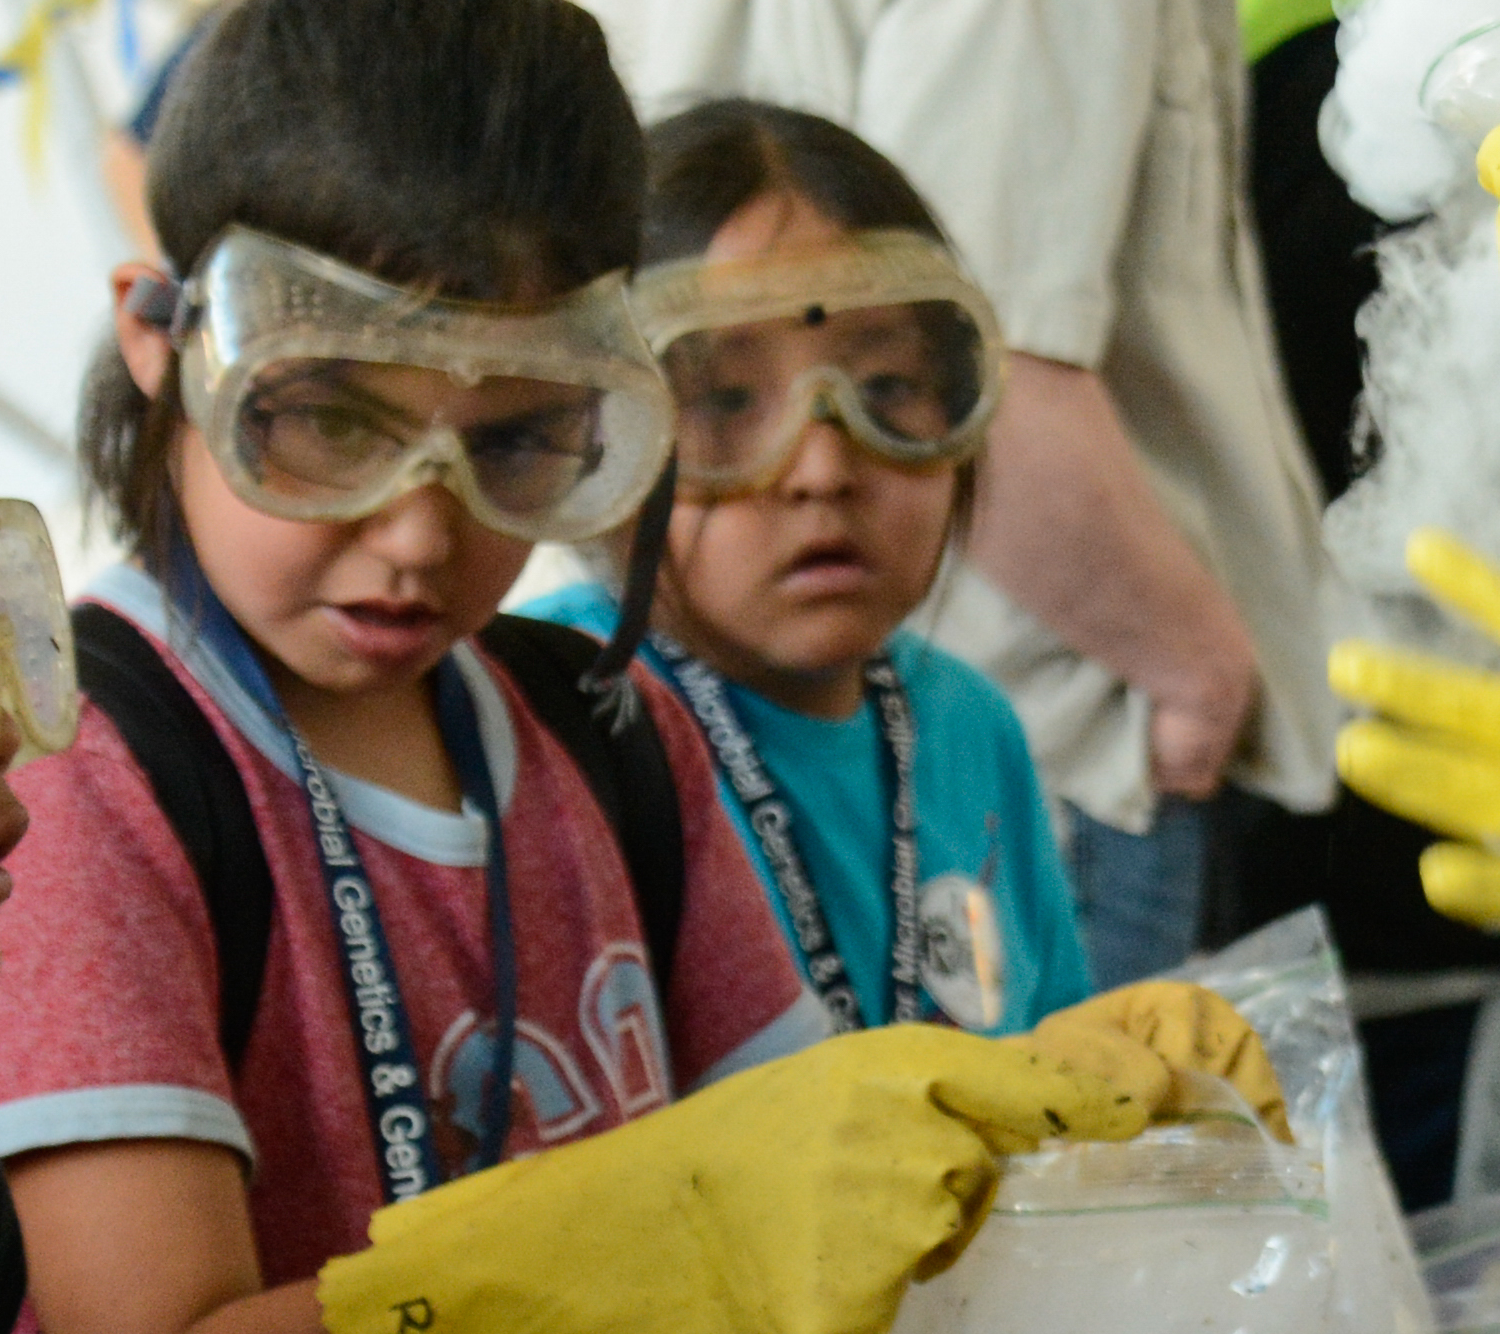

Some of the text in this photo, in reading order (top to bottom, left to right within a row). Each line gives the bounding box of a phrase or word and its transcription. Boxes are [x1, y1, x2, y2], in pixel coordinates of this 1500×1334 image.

[674, 661, 778, 804] Microbial
[751, 798, 830, 954] Genetics
[808, 952, 846, 985] &
[333, 875, 401, 1055] Genetics
[891, 834, 920, 985] Microbial
[370, 1064, 417, 1098] &
[379, 1103, 427, 1206] Gen
